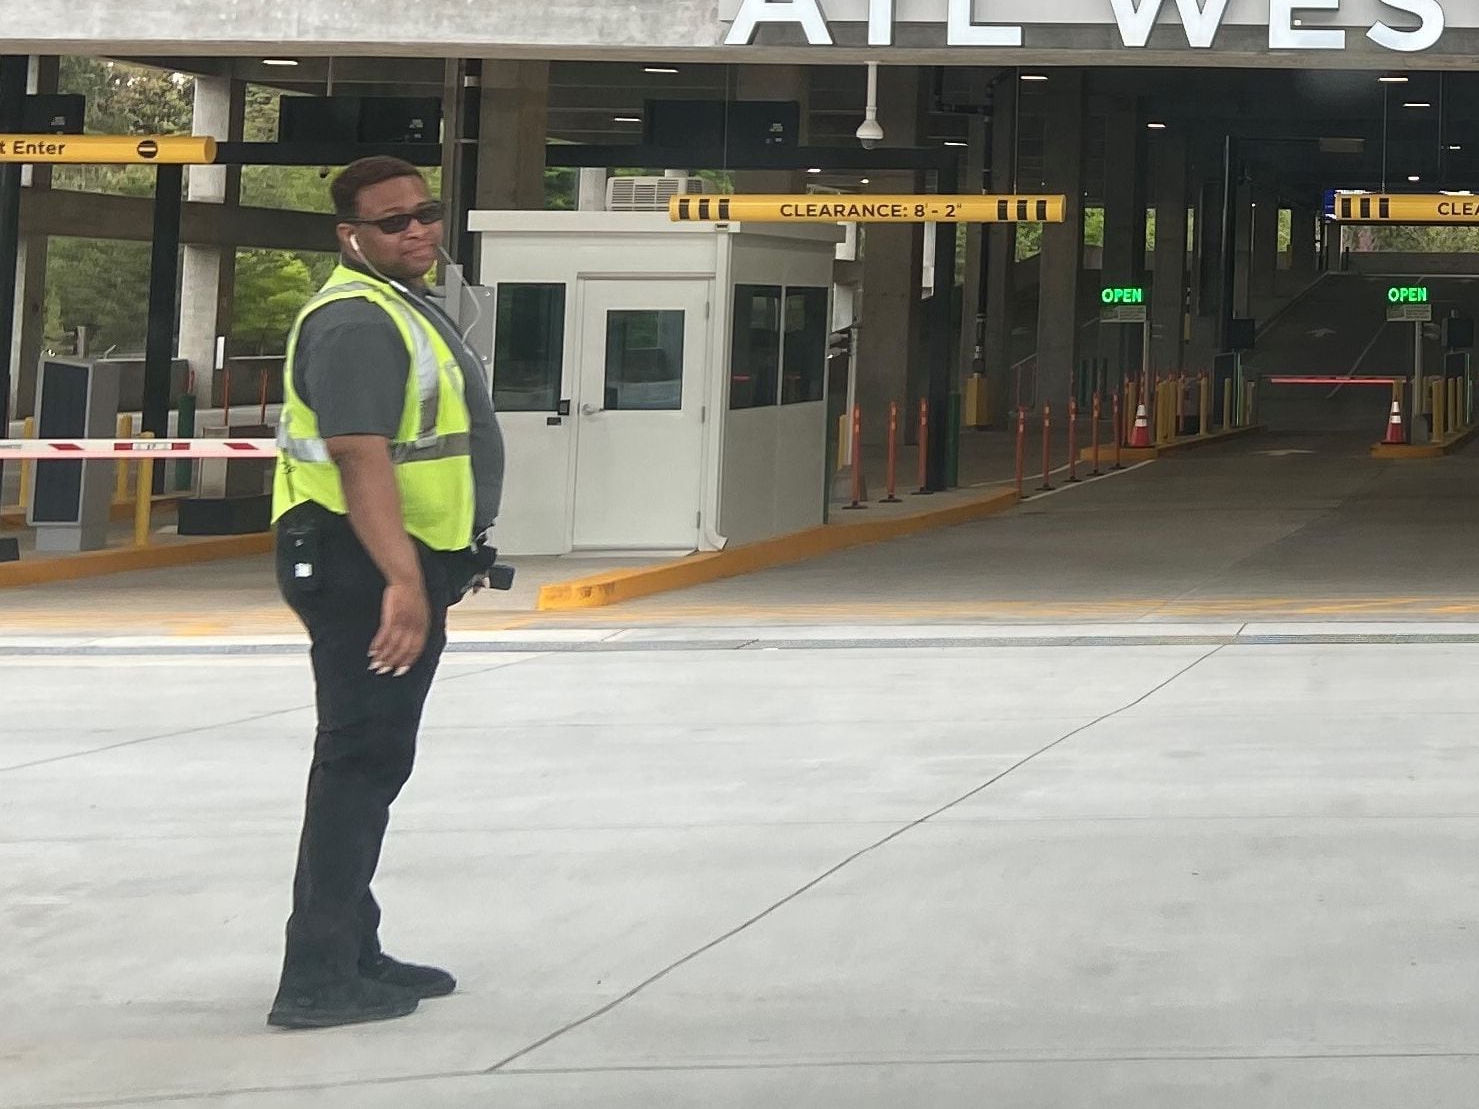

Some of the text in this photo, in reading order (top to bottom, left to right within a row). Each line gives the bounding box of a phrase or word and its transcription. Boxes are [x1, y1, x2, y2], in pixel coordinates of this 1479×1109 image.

[13, 140, 66, 155] Enter
[780, 203, 908, 219] CLEARANCE:
[1102, 288, 1142, 303] OPEN
[1388, 287, 1427, 302] OPEN
